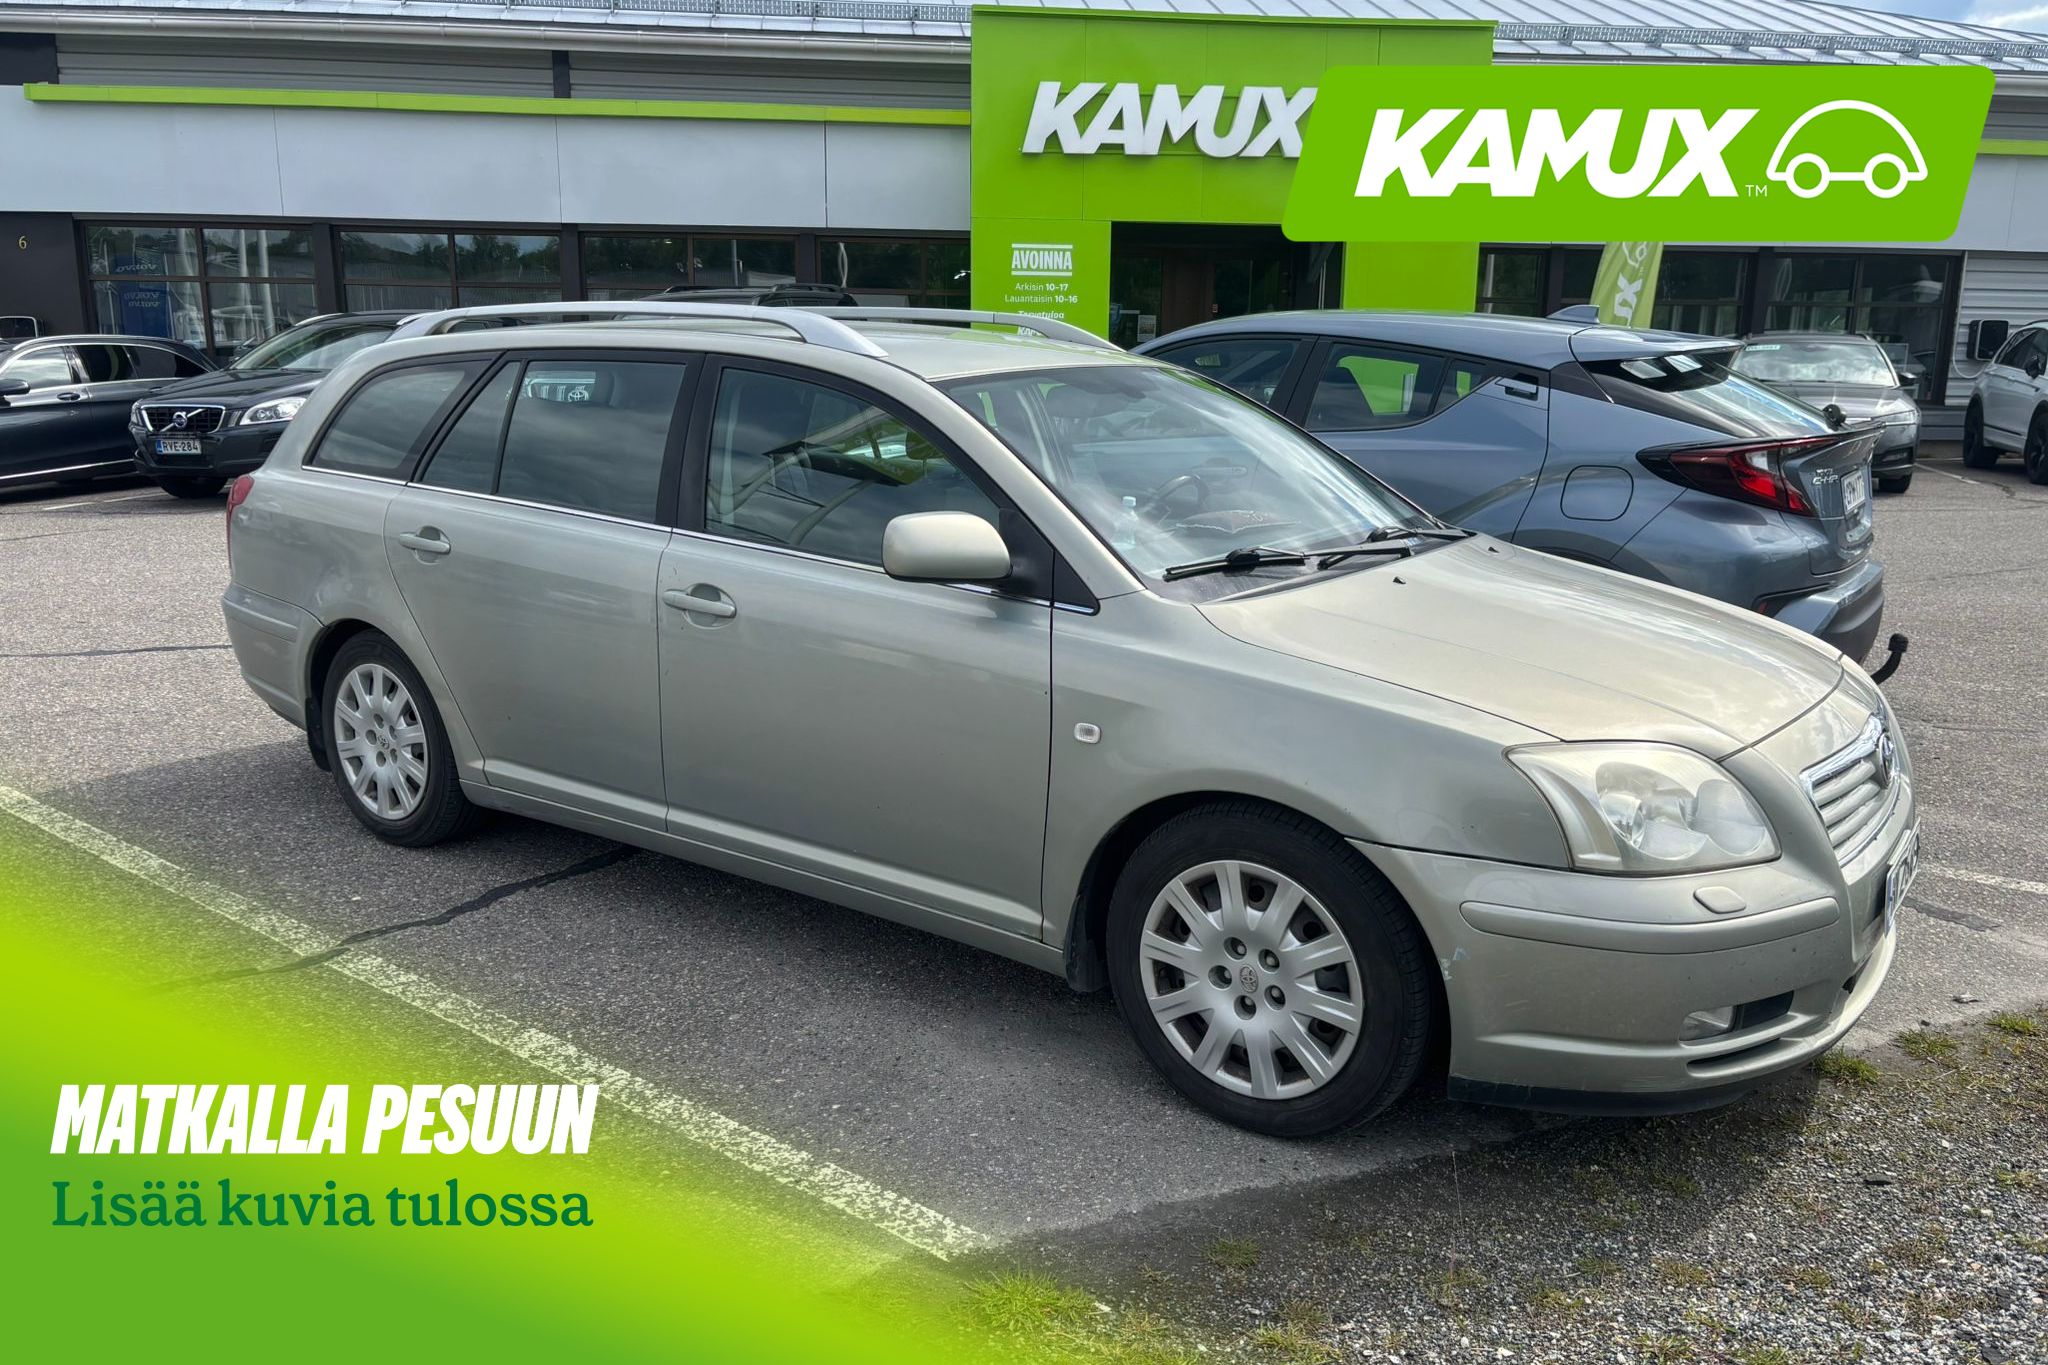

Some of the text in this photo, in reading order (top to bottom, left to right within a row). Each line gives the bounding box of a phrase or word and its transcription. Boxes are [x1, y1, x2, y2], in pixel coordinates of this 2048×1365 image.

[1021, 81, 1318, 158] KAMUX
[18, 235, 27, 250] 6
[1011, 249, 1073, 270] AVOINNA
[1015, 282, 1044, 291] Arkisin
[1004, 294, 1053, 304] Lauantaisin
